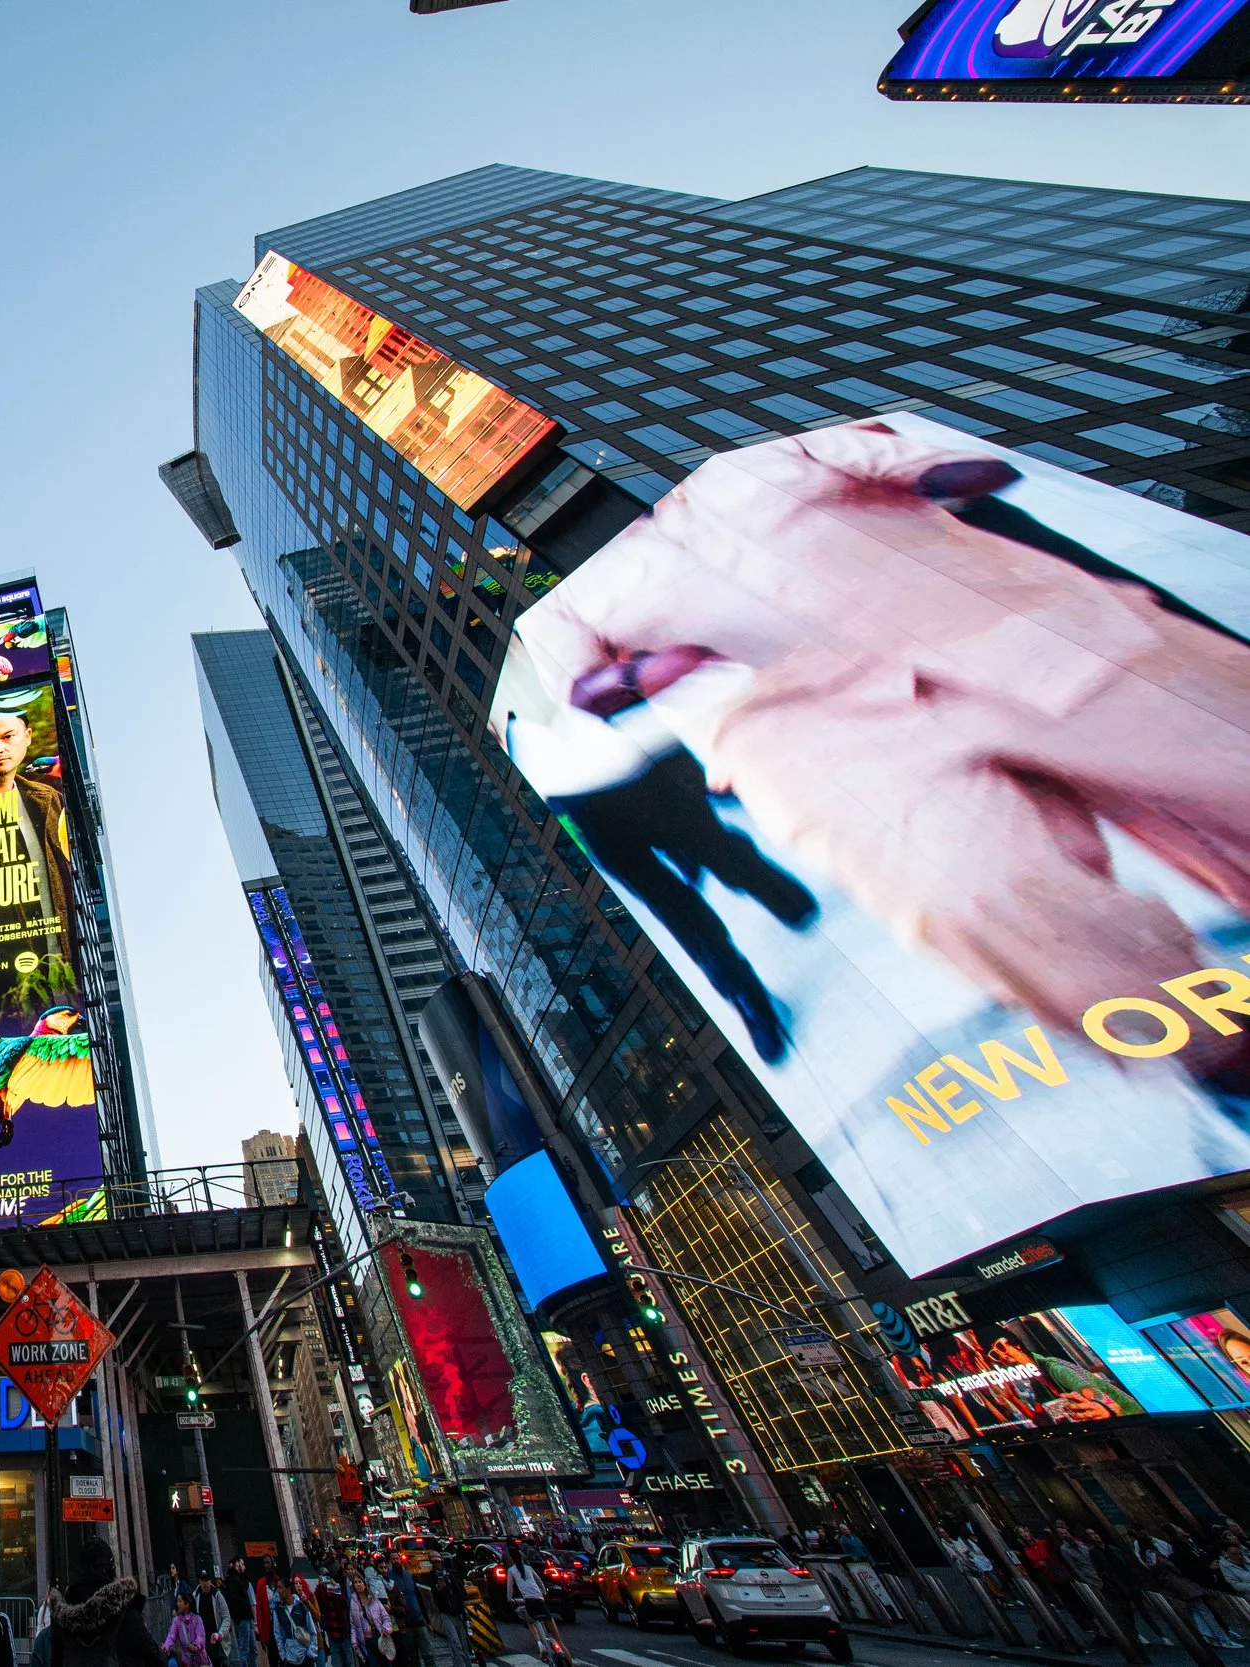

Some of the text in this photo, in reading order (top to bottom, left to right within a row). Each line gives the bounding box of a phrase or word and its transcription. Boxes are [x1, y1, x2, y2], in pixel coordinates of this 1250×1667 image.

[1, 590, 30, 603] square
[26, 915, 61, 928] NATURE
[885, 954, 1250, 1146] NEW OR
[0, 1172, 26, 1186] FOR
[27, 1169, 53, 1183] THE
[904, 1290, 974, 1338] AT&T
[11, 1342, 88, 1363] WORK ZONE
[23, 1368, 76, 1384] AHEAD
[927, 1361, 1042, 1399] very smartphone
[669, 1351, 728, 1440] TIMES
[910, 1434, 924, 1442] ONE
[487, 1464, 514, 1472] SUNDAYS
[725, 1458, 747, 1474] 3
[75, 1479, 99, 1487] SIDEWALK
[645, 1473, 715, 1491] CHASE
